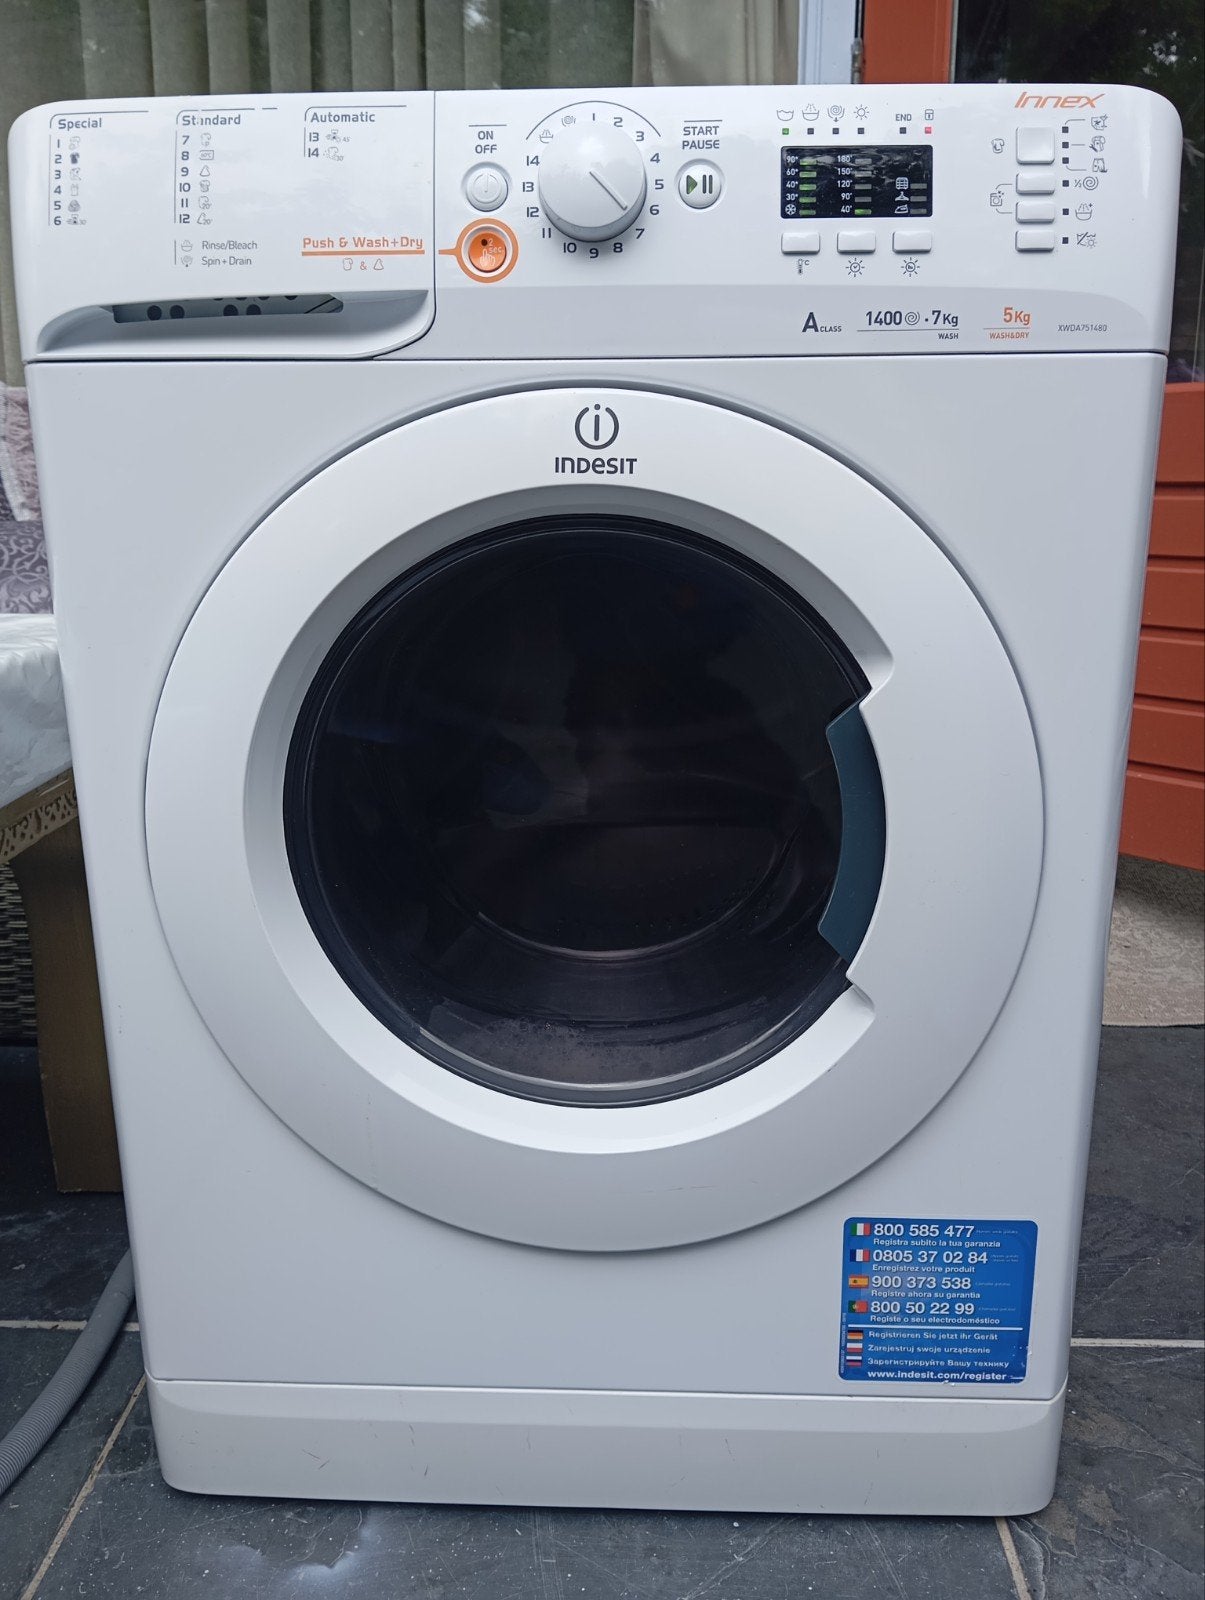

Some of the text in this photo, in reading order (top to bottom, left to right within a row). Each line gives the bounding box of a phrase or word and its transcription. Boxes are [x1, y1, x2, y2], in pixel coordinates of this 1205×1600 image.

[1014, 91, 1105, 108] Innex
[311, 112, 376, 123] Automatic
[613, 117, 623, 127] 2
[895, 113, 912, 122] END
[58, 117, 102, 131] Special
[477, 130, 494, 140] ON
[635, 130, 645, 141] 3
[683, 126, 720, 136] START
[182, 135, 190, 145] 7
[309, 132, 320, 142] 13
[475, 144, 497, 154] OFF
[682, 140, 720, 150] PAUSE
[181, 151, 190, 161] 8
[308, 147, 320, 158] 14
[54, 154, 62, 164] 2
[526, 155, 540, 166] 14
[650, 153, 660, 163] 4
[54, 170, 61, 179] 3
[181, 167, 189, 177] 9
[179, 183, 191, 192] 10
[522, 182, 535, 192] 13
[655, 179, 664, 189] 5
[53, 185, 62, 195] 4
[54, 201, 61, 210] 5
[181, 198, 188, 208] 11
[526, 207, 540, 217] 12
[649, 204, 660, 215] 6
[54, 216, 62, 226] 6
[179, 214, 190, 223] 12
[542, 228, 552, 238] 11
[635, 229, 645, 239] 7
[202, 240, 258, 250] Rinse/Bleach
[303, 236, 423, 250] Push & Wash+Dry
[488, 238, 493, 246] 2
[563, 242, 577, 253] 10
[613, 242, 623, 253] 8
[589, 248, 599, 259] 9
[202, 256, 221, 267] Spin
[229, 256, 252, 266] Drain
[359, 261, 367, 270] &
[865, 311, 902, 326] 1400
[1003, 306, 1031, 325] 5Kg
[802, 312, 819, 333] A
[1057, 324, 1108, 332] XWDA751480
[989, 332, 1029, 340] WASH&DRY
[874, 1224, 904, 1237] 800
[909, 1225, 939, 1237] 585
[944, 1225, 975, 1238] 477
[873, 1238, 908, 1247] Registra
[939, 1239, 947, 1247] la
[965, 1240, 1001, 1249] garanzia
[873, 1250, 913, 1262] 0805
[918, 1251, 938, 1263] 37
[943, 1251, 963, 1264] 02
[968, 1252, 988, 1264] 84
[872, 1264, 919, 1273] Enregistrez
[871, 1275, 972, 1289] 900 373 538
[871, 1289, 906, 1298] Registre
[908, 1290, 932, 1298] ahora
[870, 1301, 975, 1315] 800 50 22 99
[870, 1315, 902, 1324] Registe
[928, 1316, 1001, 1325] electrodoméstico
[868, 1331, 921, 1339] Registrieren
[938, 1333, 958, 1341] jetzt
[973, 1333, 998, 1341] Gerät
[868, 1344, 991, 1355] Zarejestruj swoje urządzenie
[867, 1357, 1010, 1369] Зарегистрируйте Вашу технику
[867, 1370, 1007, 1381] www.indesit.com/register
